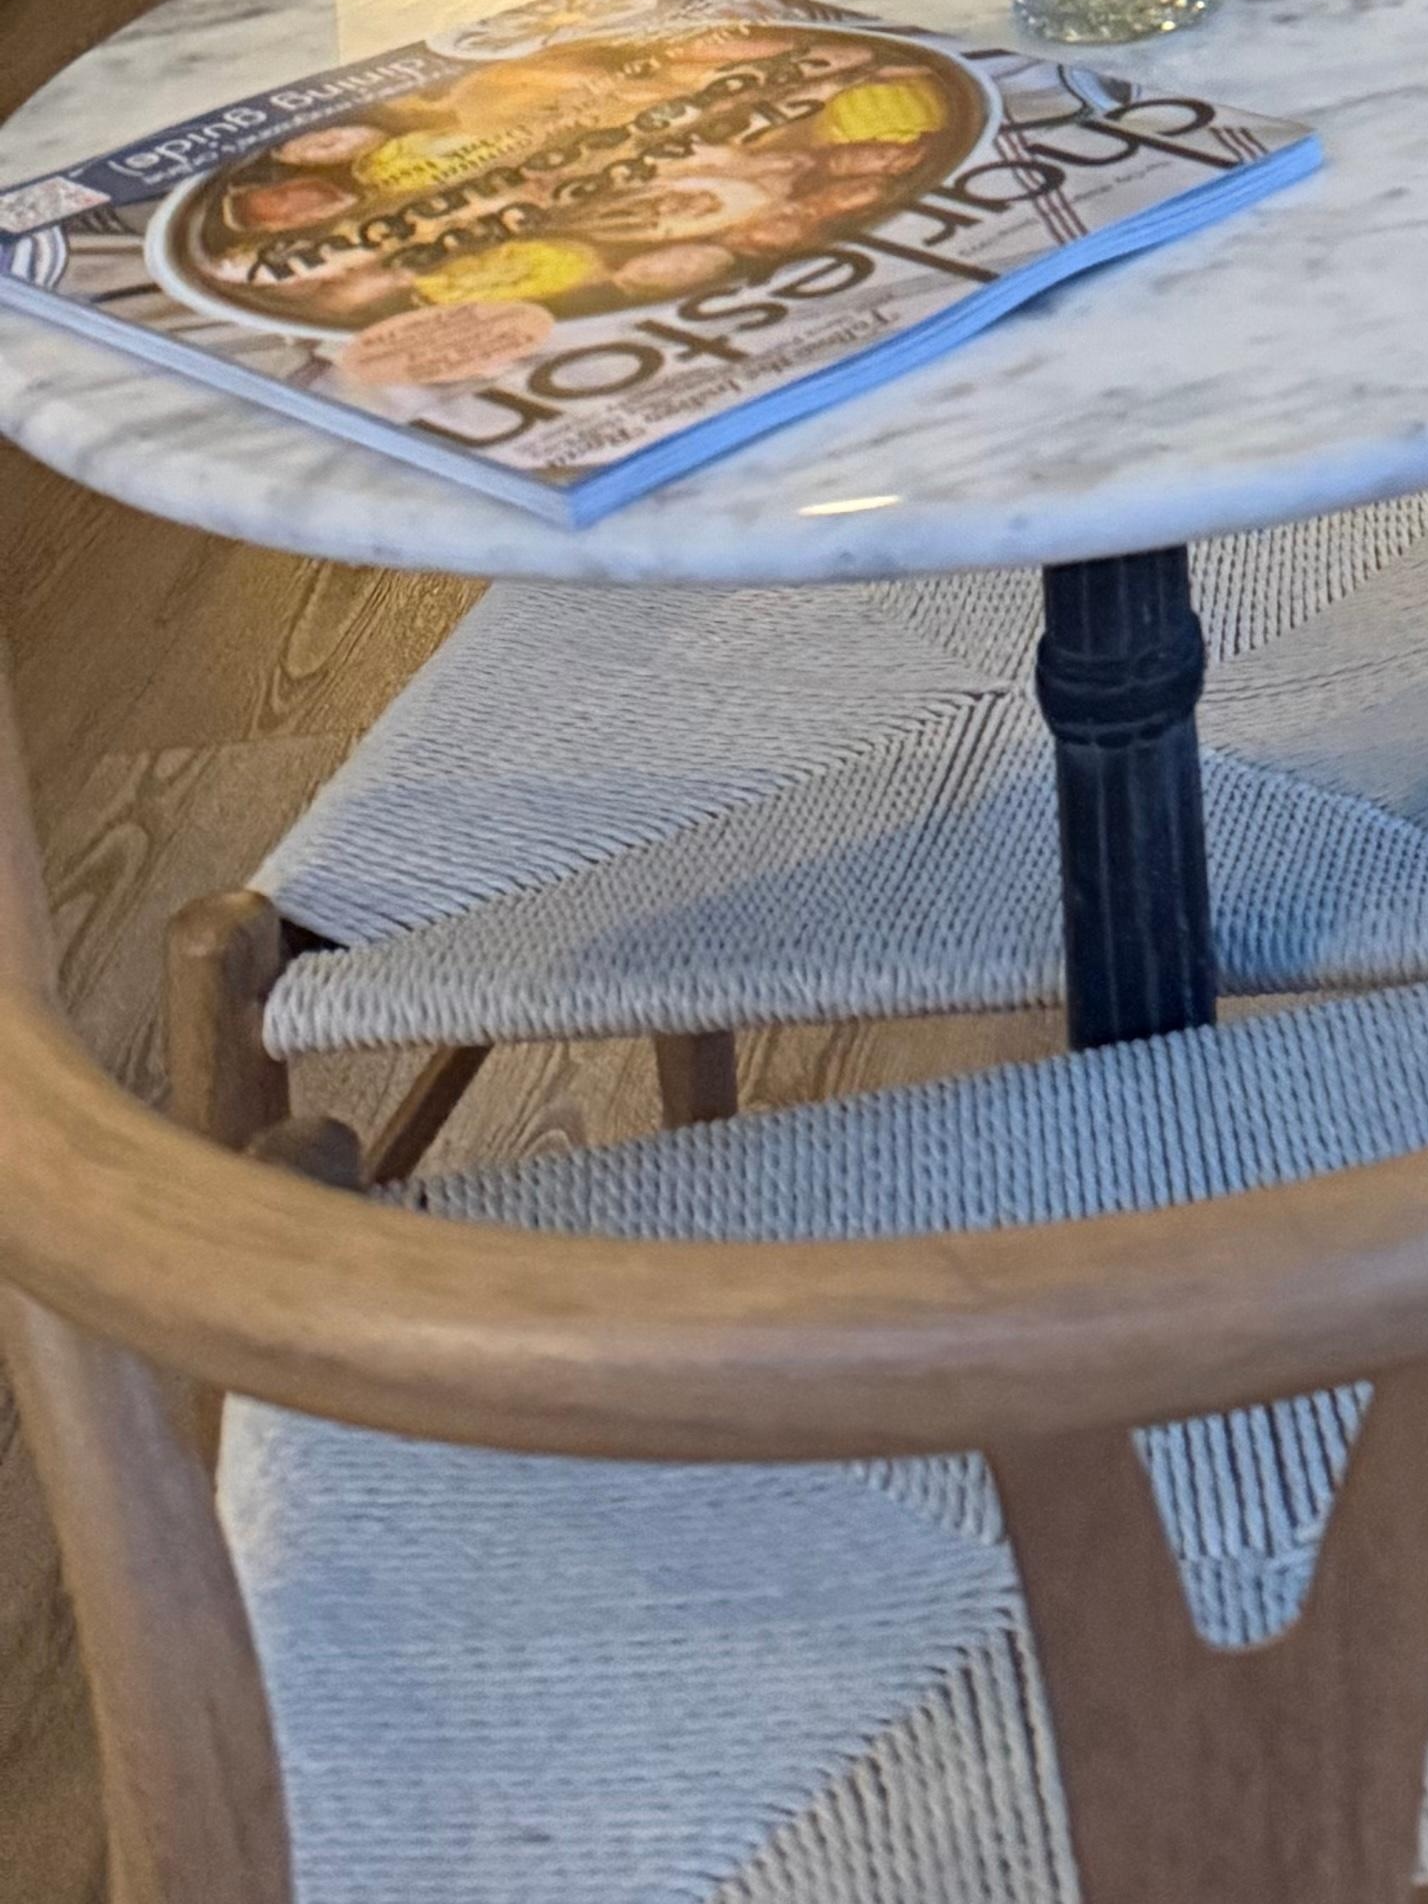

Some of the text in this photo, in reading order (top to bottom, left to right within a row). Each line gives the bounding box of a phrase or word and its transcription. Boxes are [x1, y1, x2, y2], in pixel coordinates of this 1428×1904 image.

[270, 58, 426, 110] dining
[246, 41, 830, 285] Lowcountry
[551, 96, 825, 203] Taste
[382, 204, 547, 273] the
[408, 98, 1215, 449] charleston
